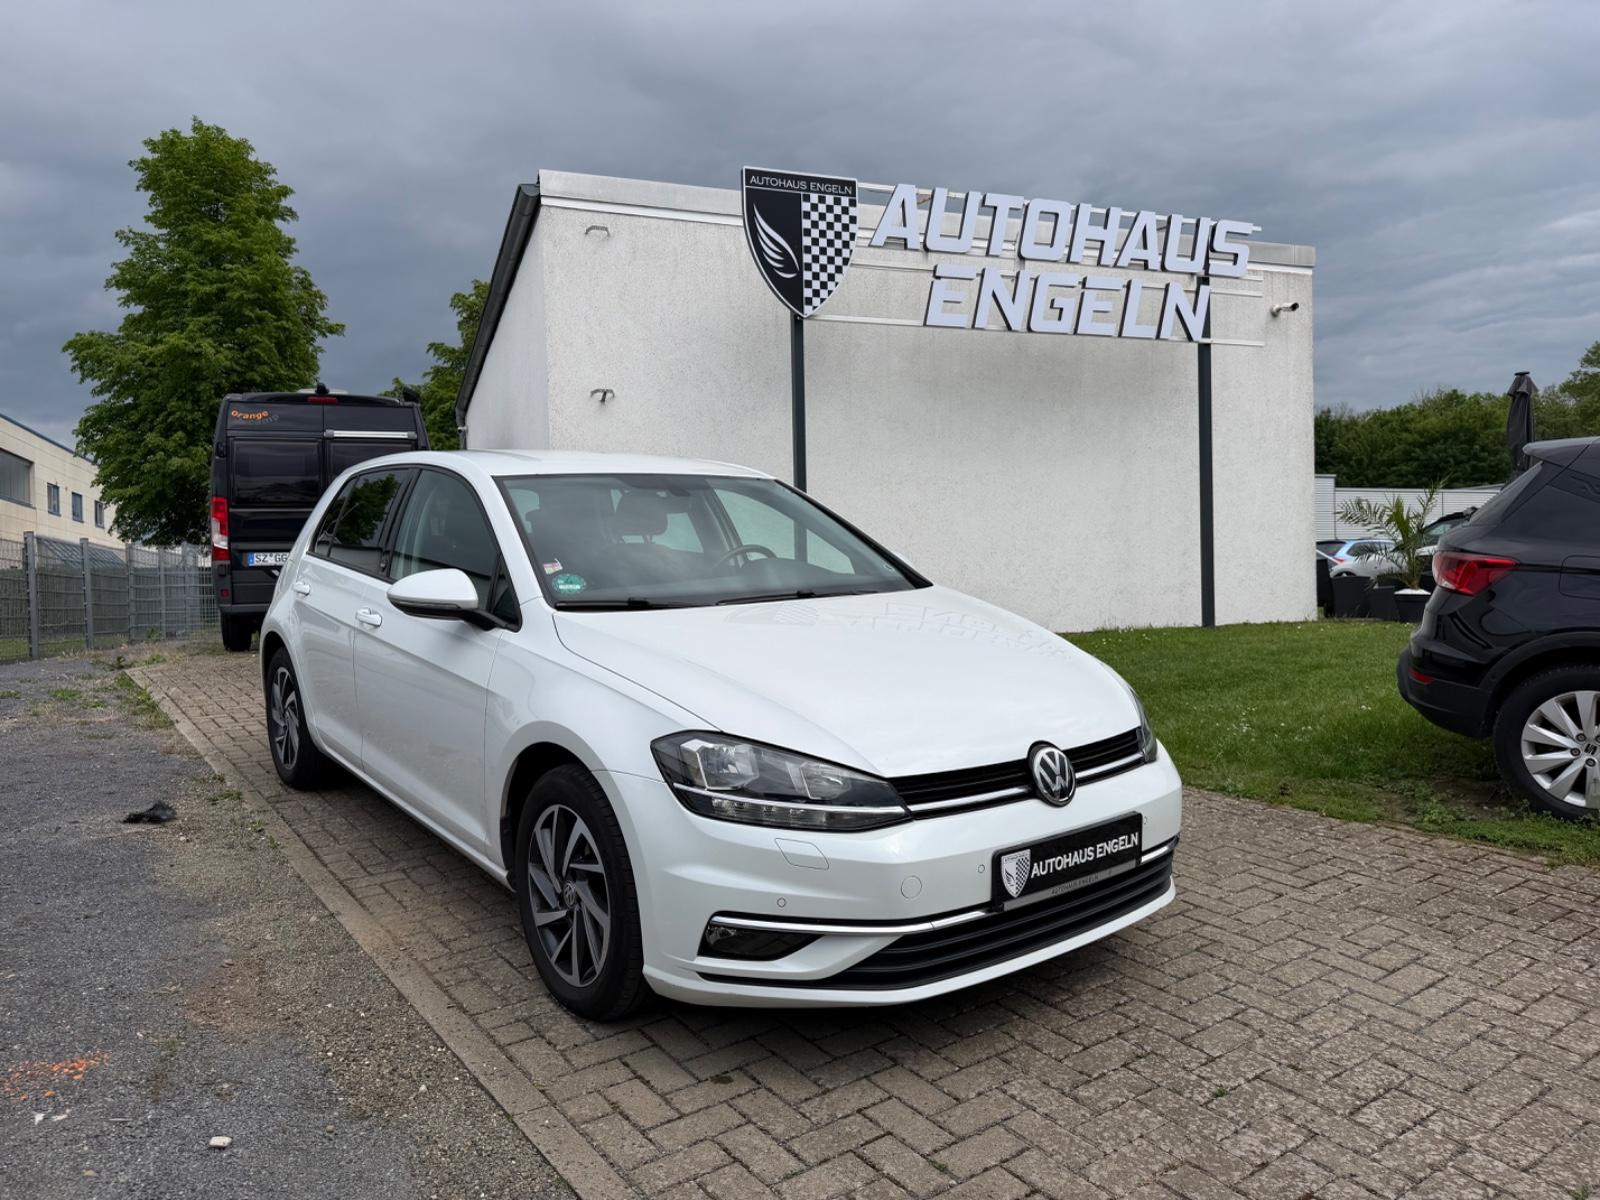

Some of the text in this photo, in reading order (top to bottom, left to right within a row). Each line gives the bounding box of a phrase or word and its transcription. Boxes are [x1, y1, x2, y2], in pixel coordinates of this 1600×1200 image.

[750, 175, 852, 194] AUTOHAUS ENGELN
[868, 183, 1256, 278] AUTOHAUS
[924, 263, 1211, 342] ENGELN
[1030, 832, 1139, 879] AUTOHAUS ENGELN
